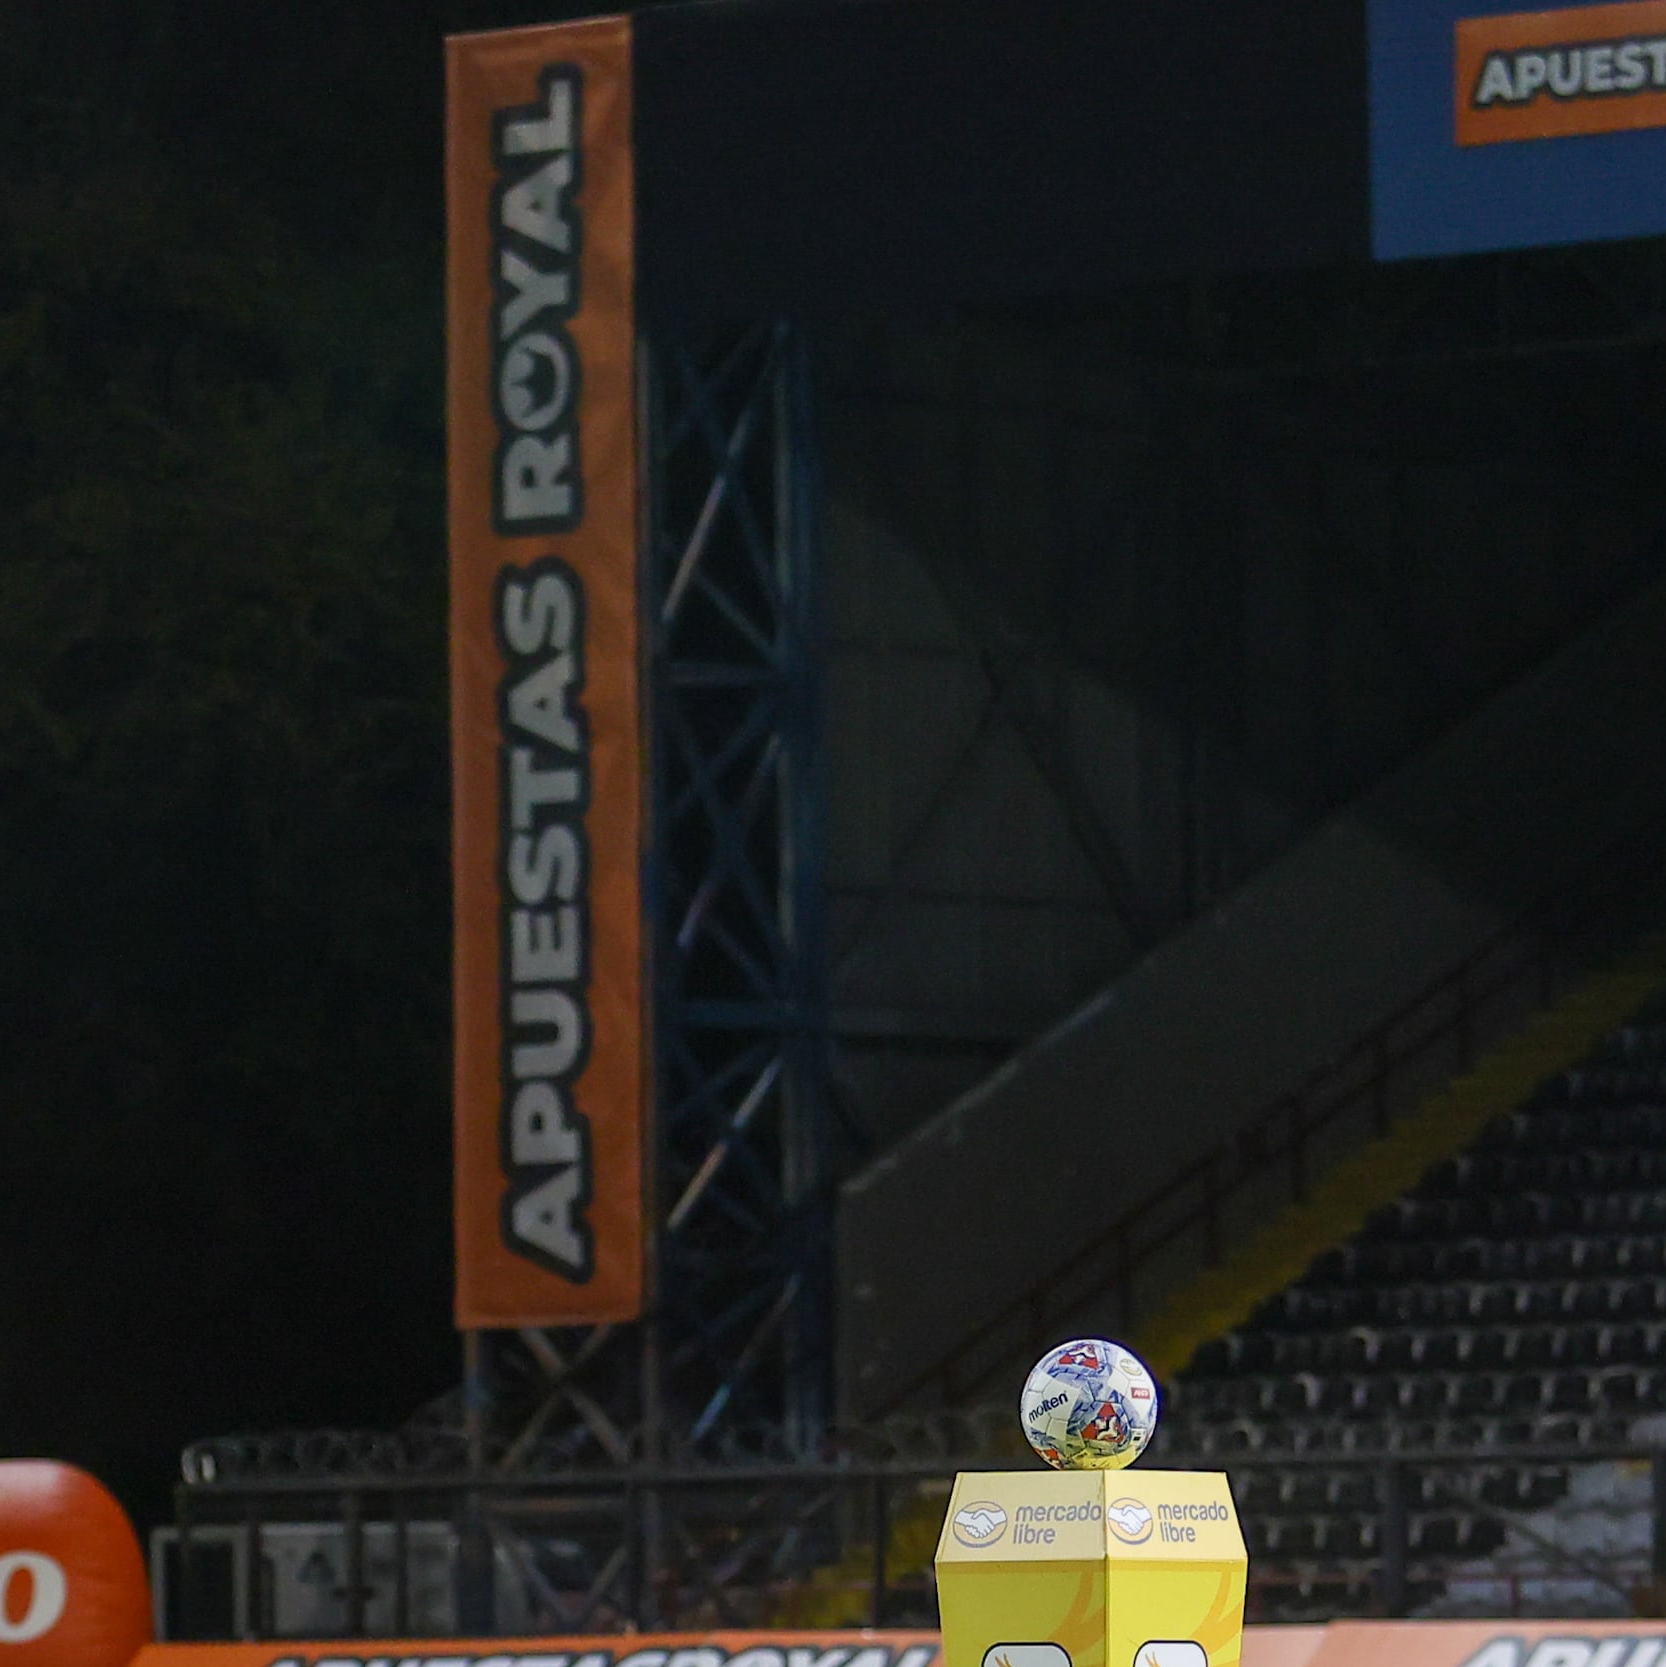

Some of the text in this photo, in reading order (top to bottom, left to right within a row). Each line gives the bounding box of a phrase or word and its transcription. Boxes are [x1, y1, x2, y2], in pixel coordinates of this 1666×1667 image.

[499, 78, 586, 1272] APUESTAS ROYAL
[1027, 1392, 1069, 1424] molten
[1015, 1500, 1102, 1523] mercado
[1156, 1500, 1229, 1522] mercado
[1012, 1523, 1057, 1545] libre
[1159, 1521, 1197, 1543] libre
